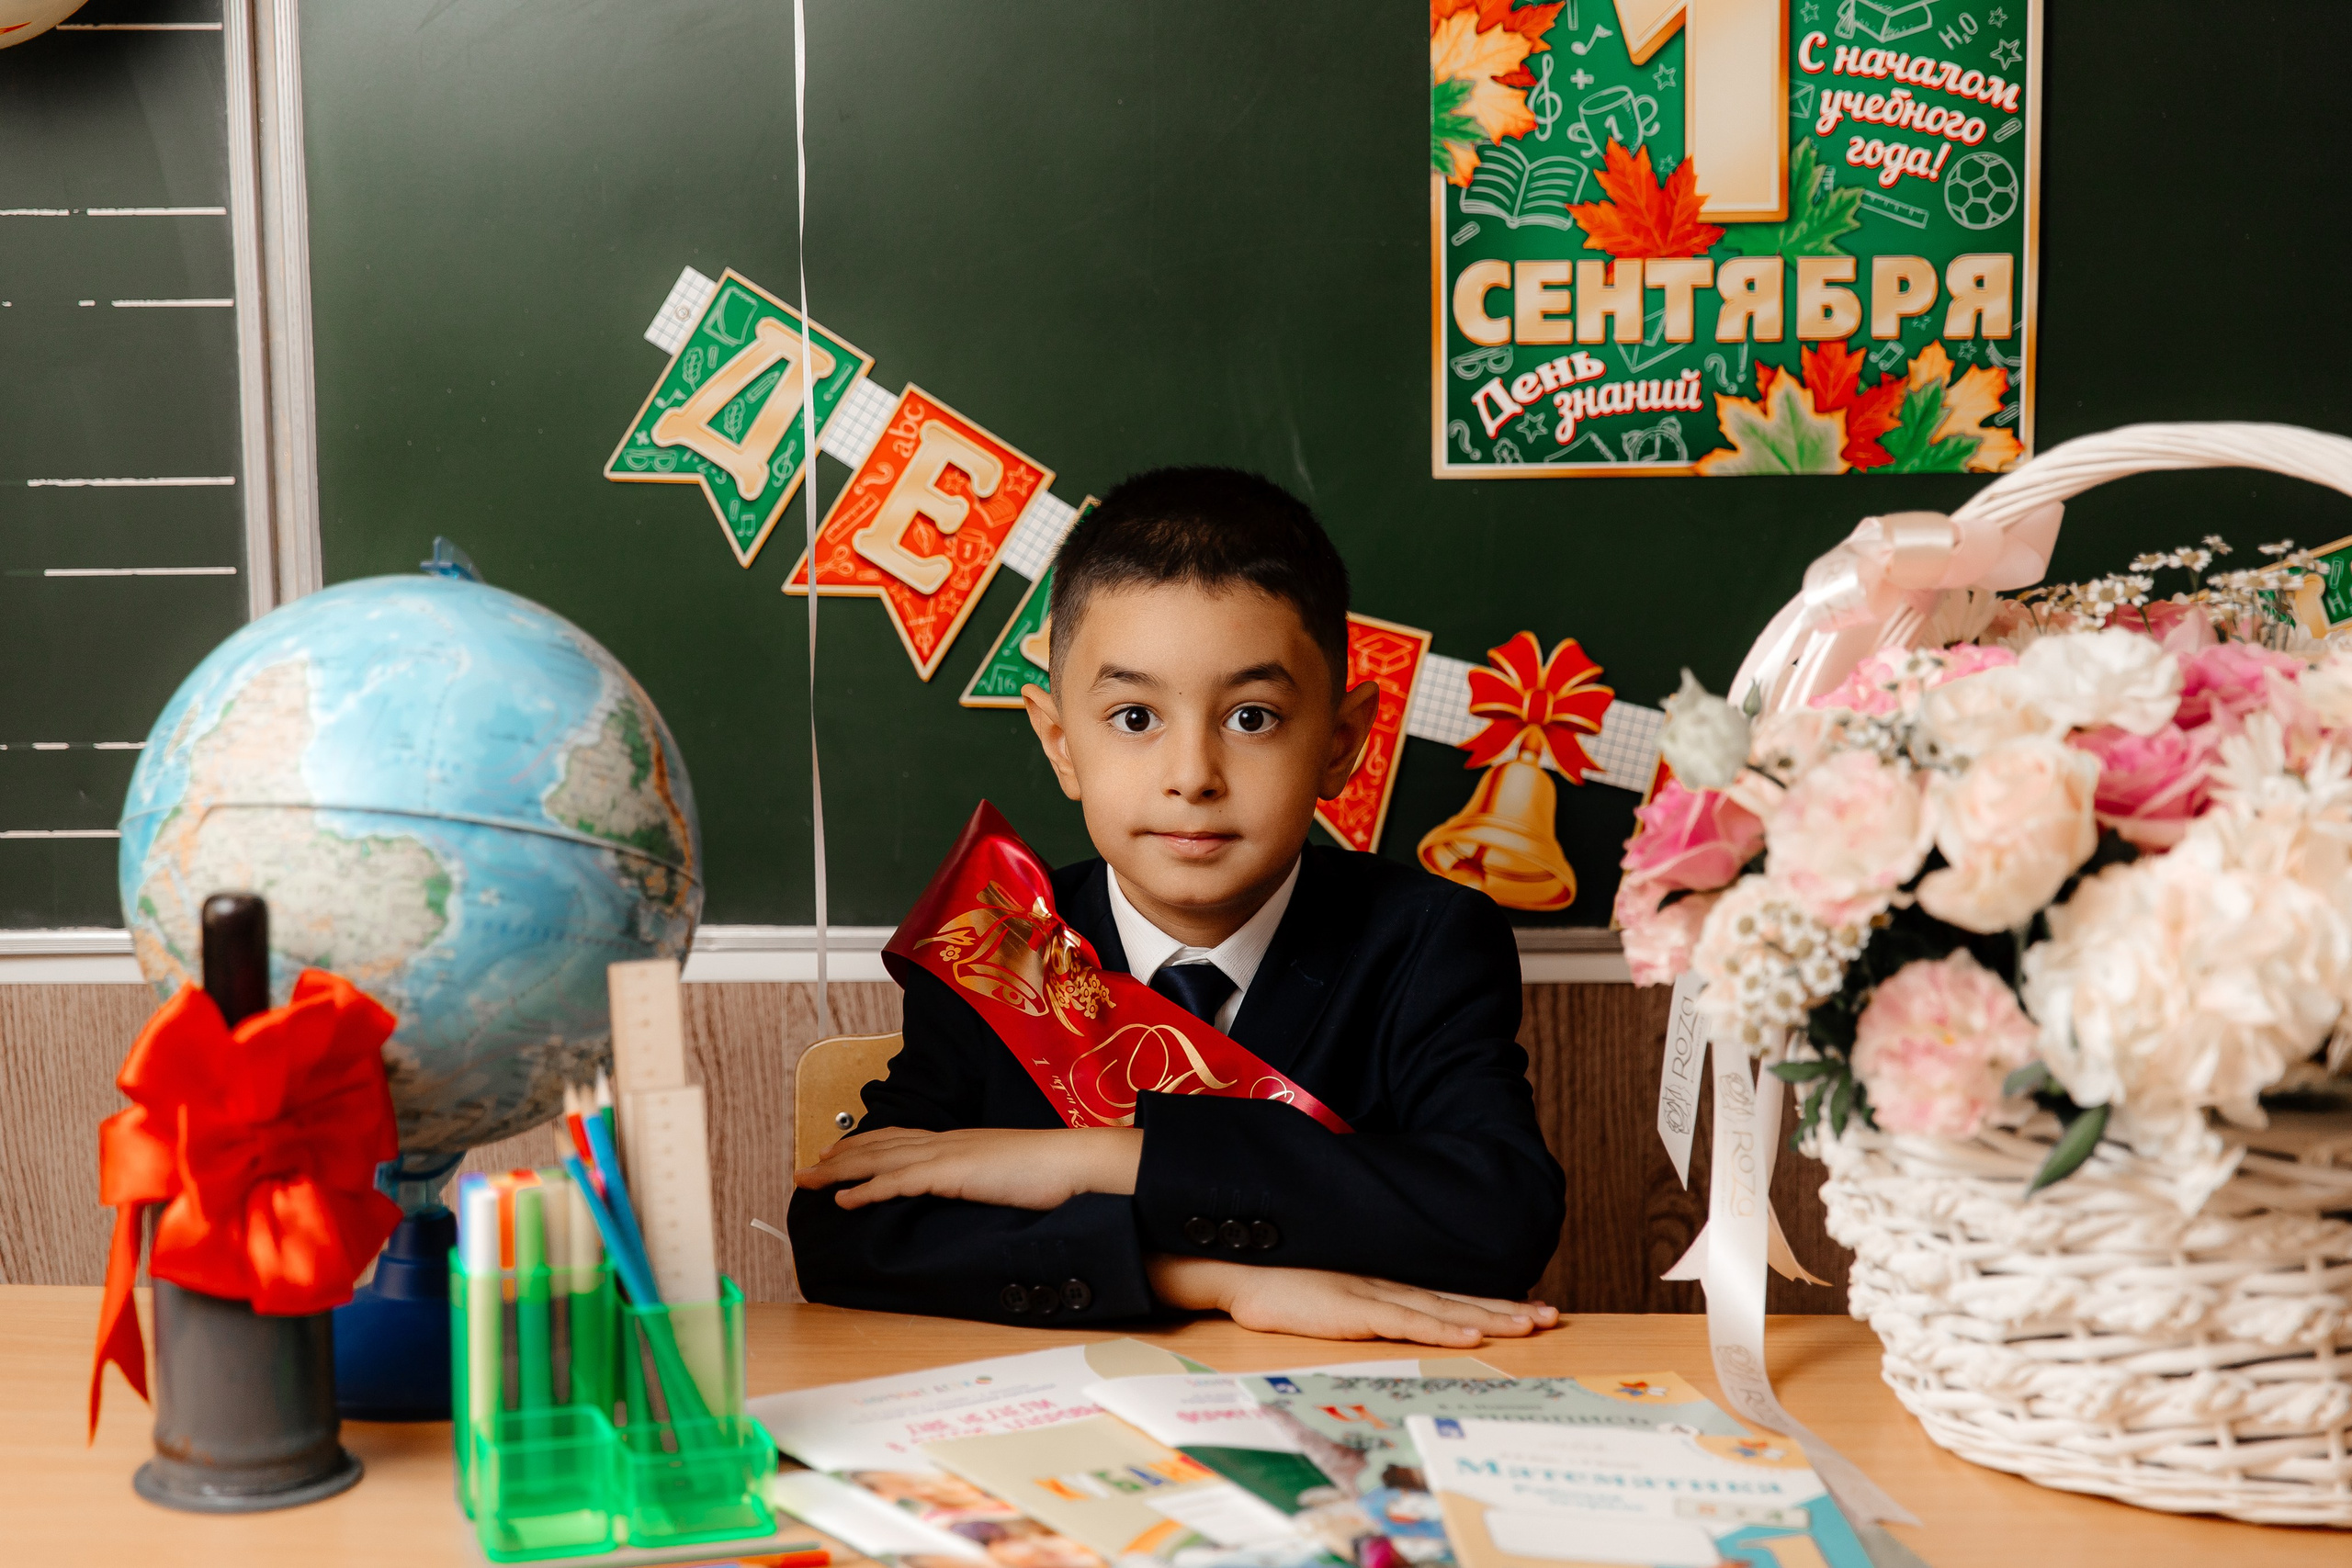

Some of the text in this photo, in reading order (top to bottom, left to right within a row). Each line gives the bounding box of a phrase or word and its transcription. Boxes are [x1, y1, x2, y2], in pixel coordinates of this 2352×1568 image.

[1798, 30, 2021, 113] С началом
[1815, 88, 1987, 146] учебного
[1846, 135, 1952, 188] года!
[1453, 254, 2014, 345] СЕНТЯБРЯ
[1471, 350, 1607, 440] День
[1553, 367, 1703, 446] знаний
